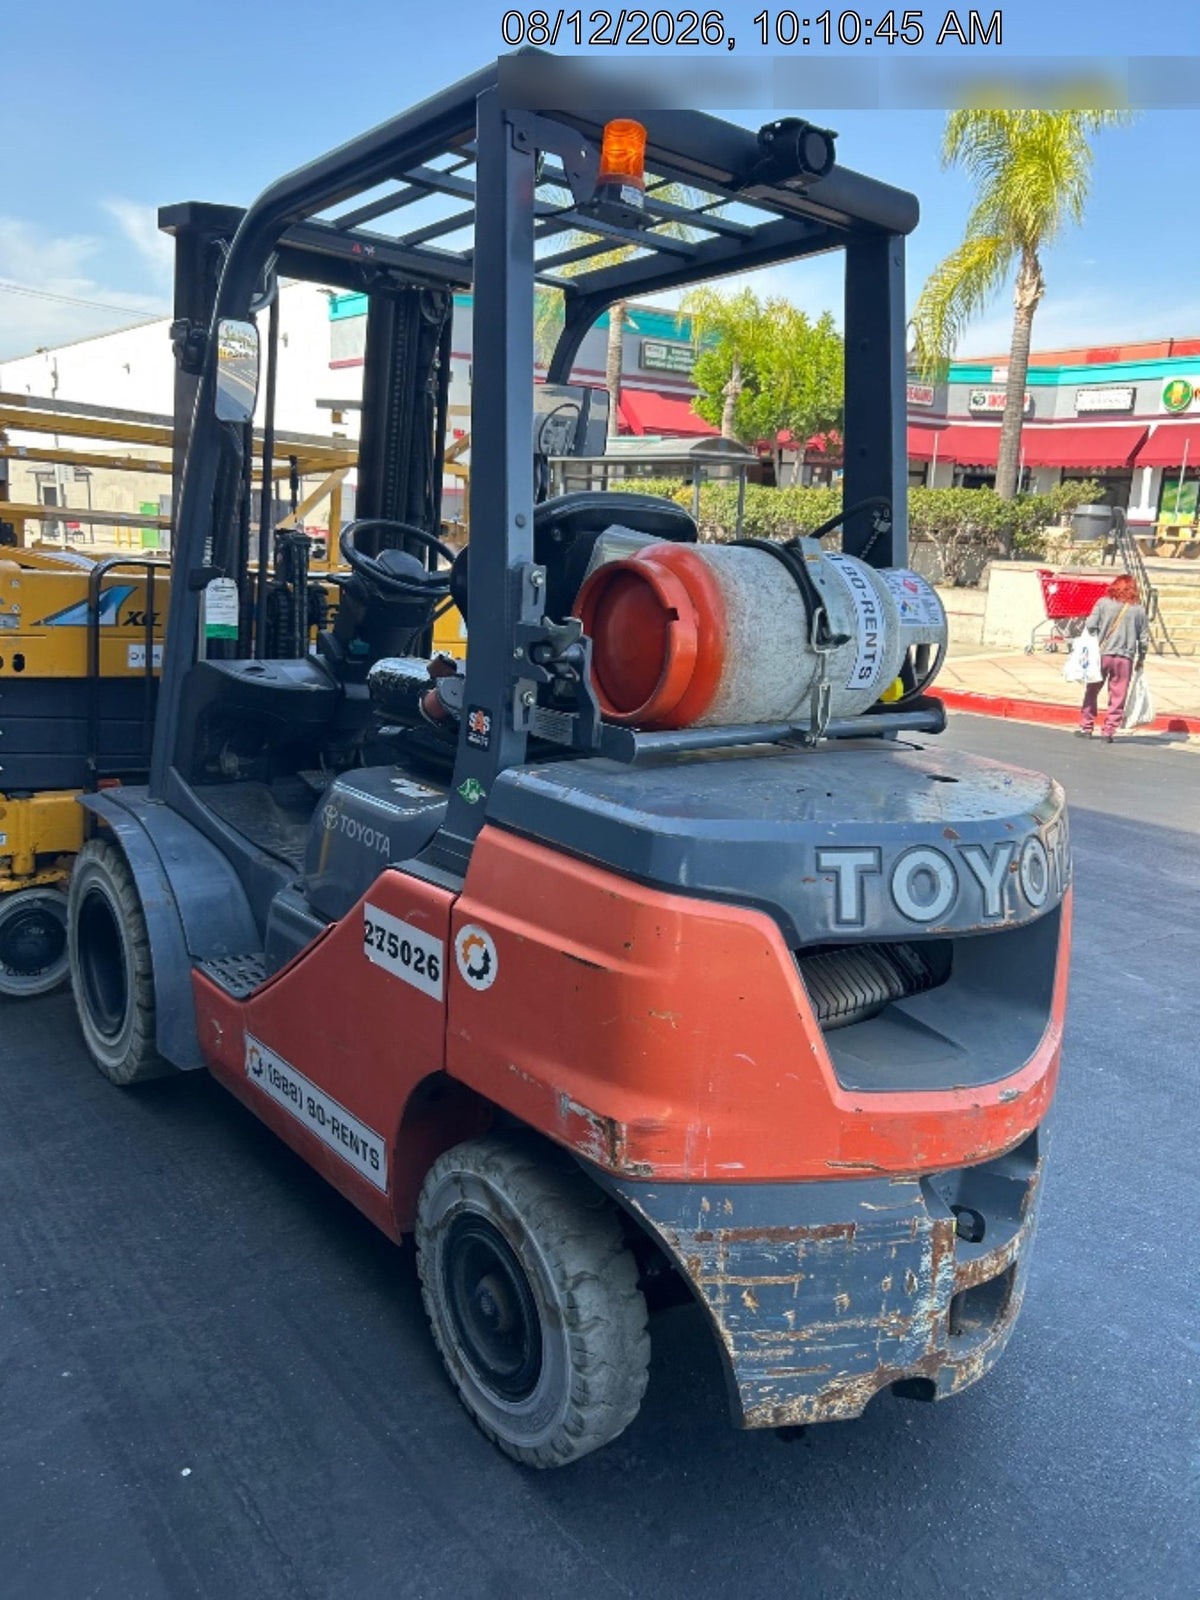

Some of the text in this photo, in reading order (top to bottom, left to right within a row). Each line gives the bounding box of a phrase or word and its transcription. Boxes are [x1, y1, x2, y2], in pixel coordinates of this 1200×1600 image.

[339, 812, 391, 858] TOYOTA
[363, 919, 440, 982] 275026
[267, 1063, 303, 1110] (888)
